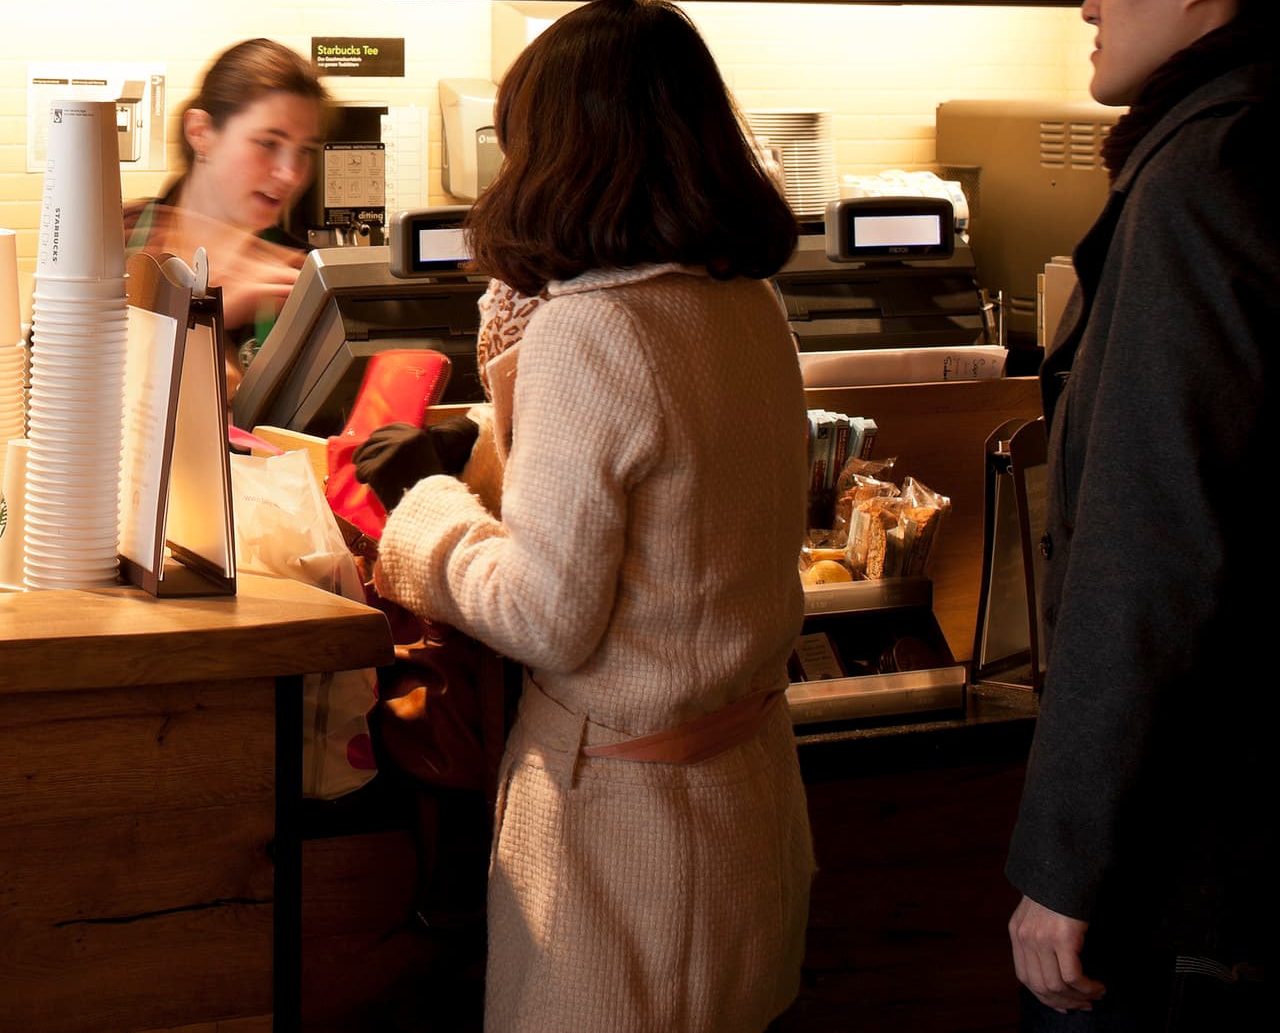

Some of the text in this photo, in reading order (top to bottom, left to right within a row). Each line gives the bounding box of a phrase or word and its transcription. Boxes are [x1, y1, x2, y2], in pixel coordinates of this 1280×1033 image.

[317, 45, 378, 56] Starbucks Tee
[358, 210, 384, 224] ditting
[52, 208, 61, 262] STARBUCKS
